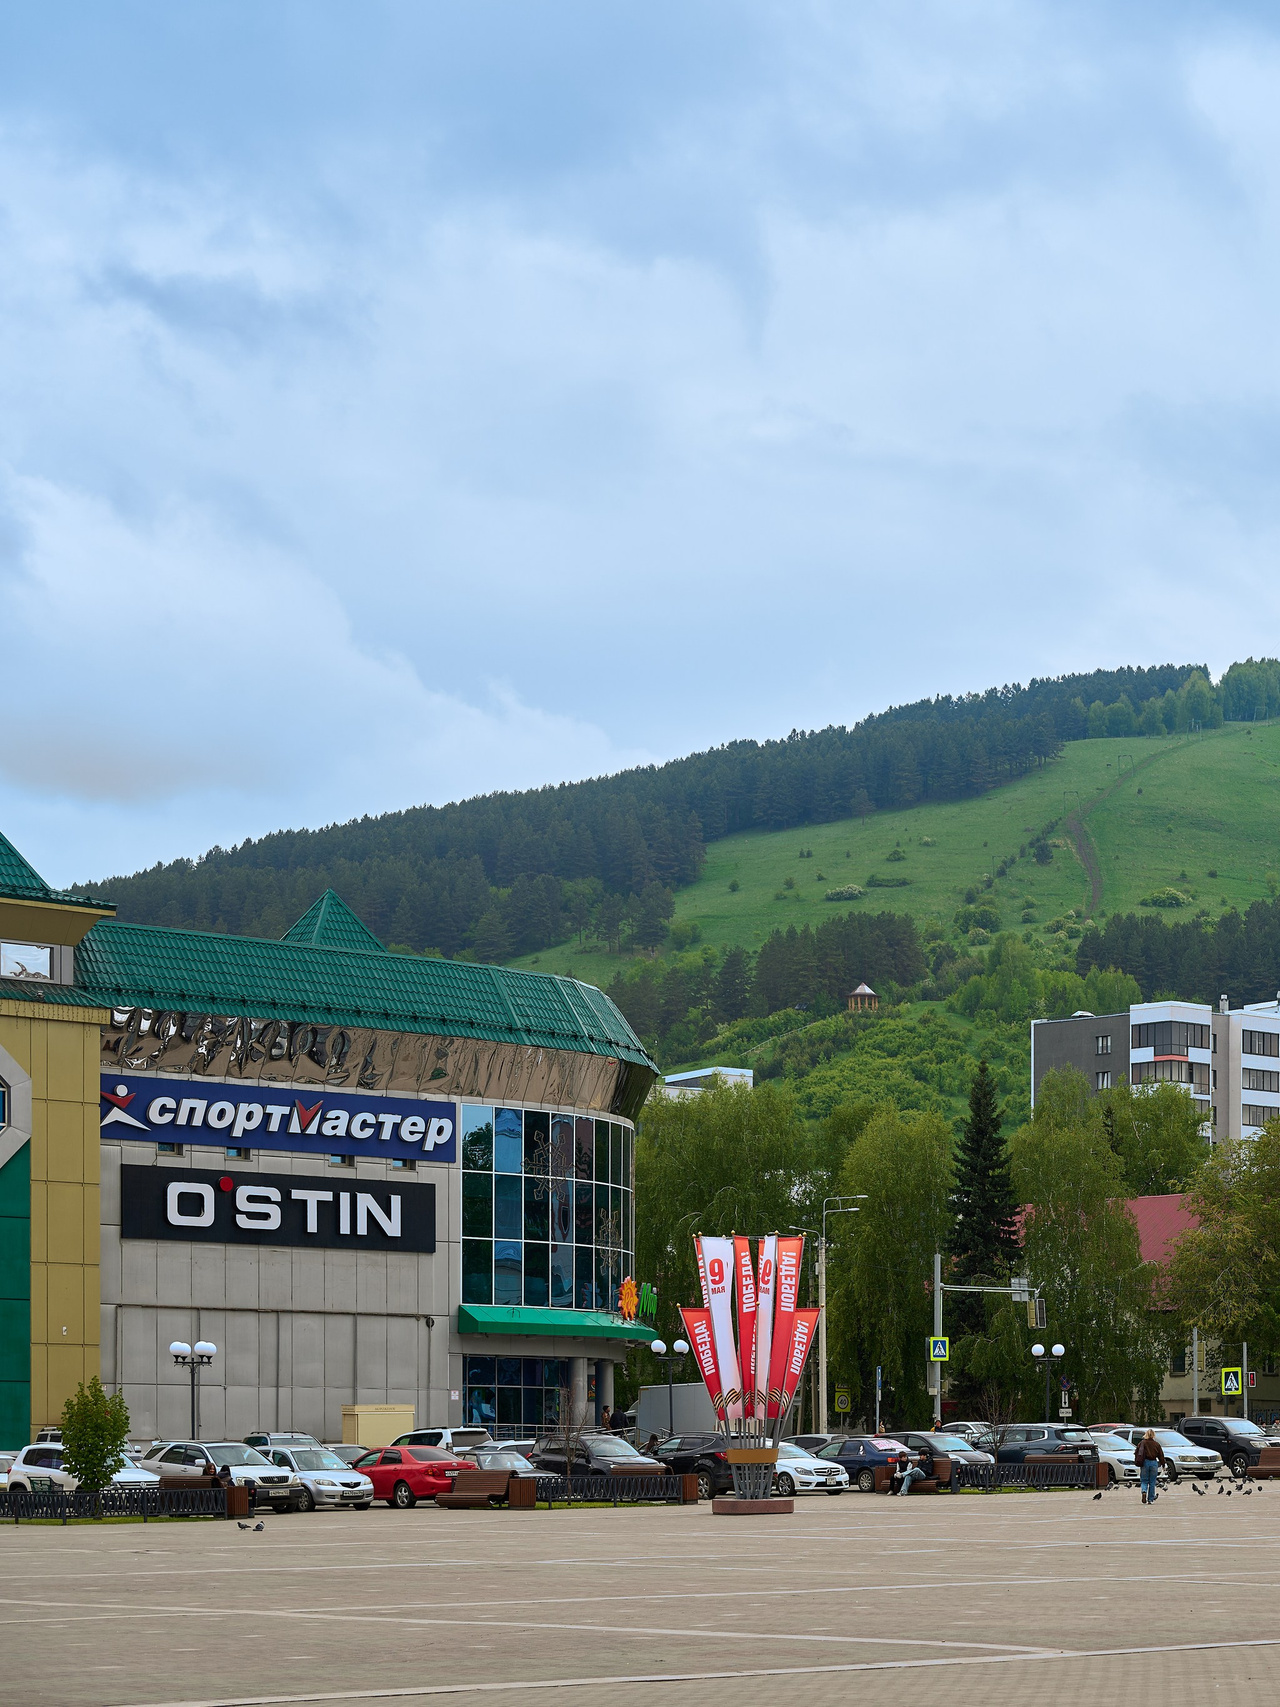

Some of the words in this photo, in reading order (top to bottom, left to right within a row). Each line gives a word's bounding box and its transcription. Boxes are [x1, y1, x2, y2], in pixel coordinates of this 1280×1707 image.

[166, 1176, 402, 1237] O'STIN
[708, 1258, 725, 1286] 9
[711, 1286, 726, 1295] МАЯ
[740, 1251, 756, 1313] ПОБЕДА!
[693, 1320, 716, 1376] ПОБЕДА!
